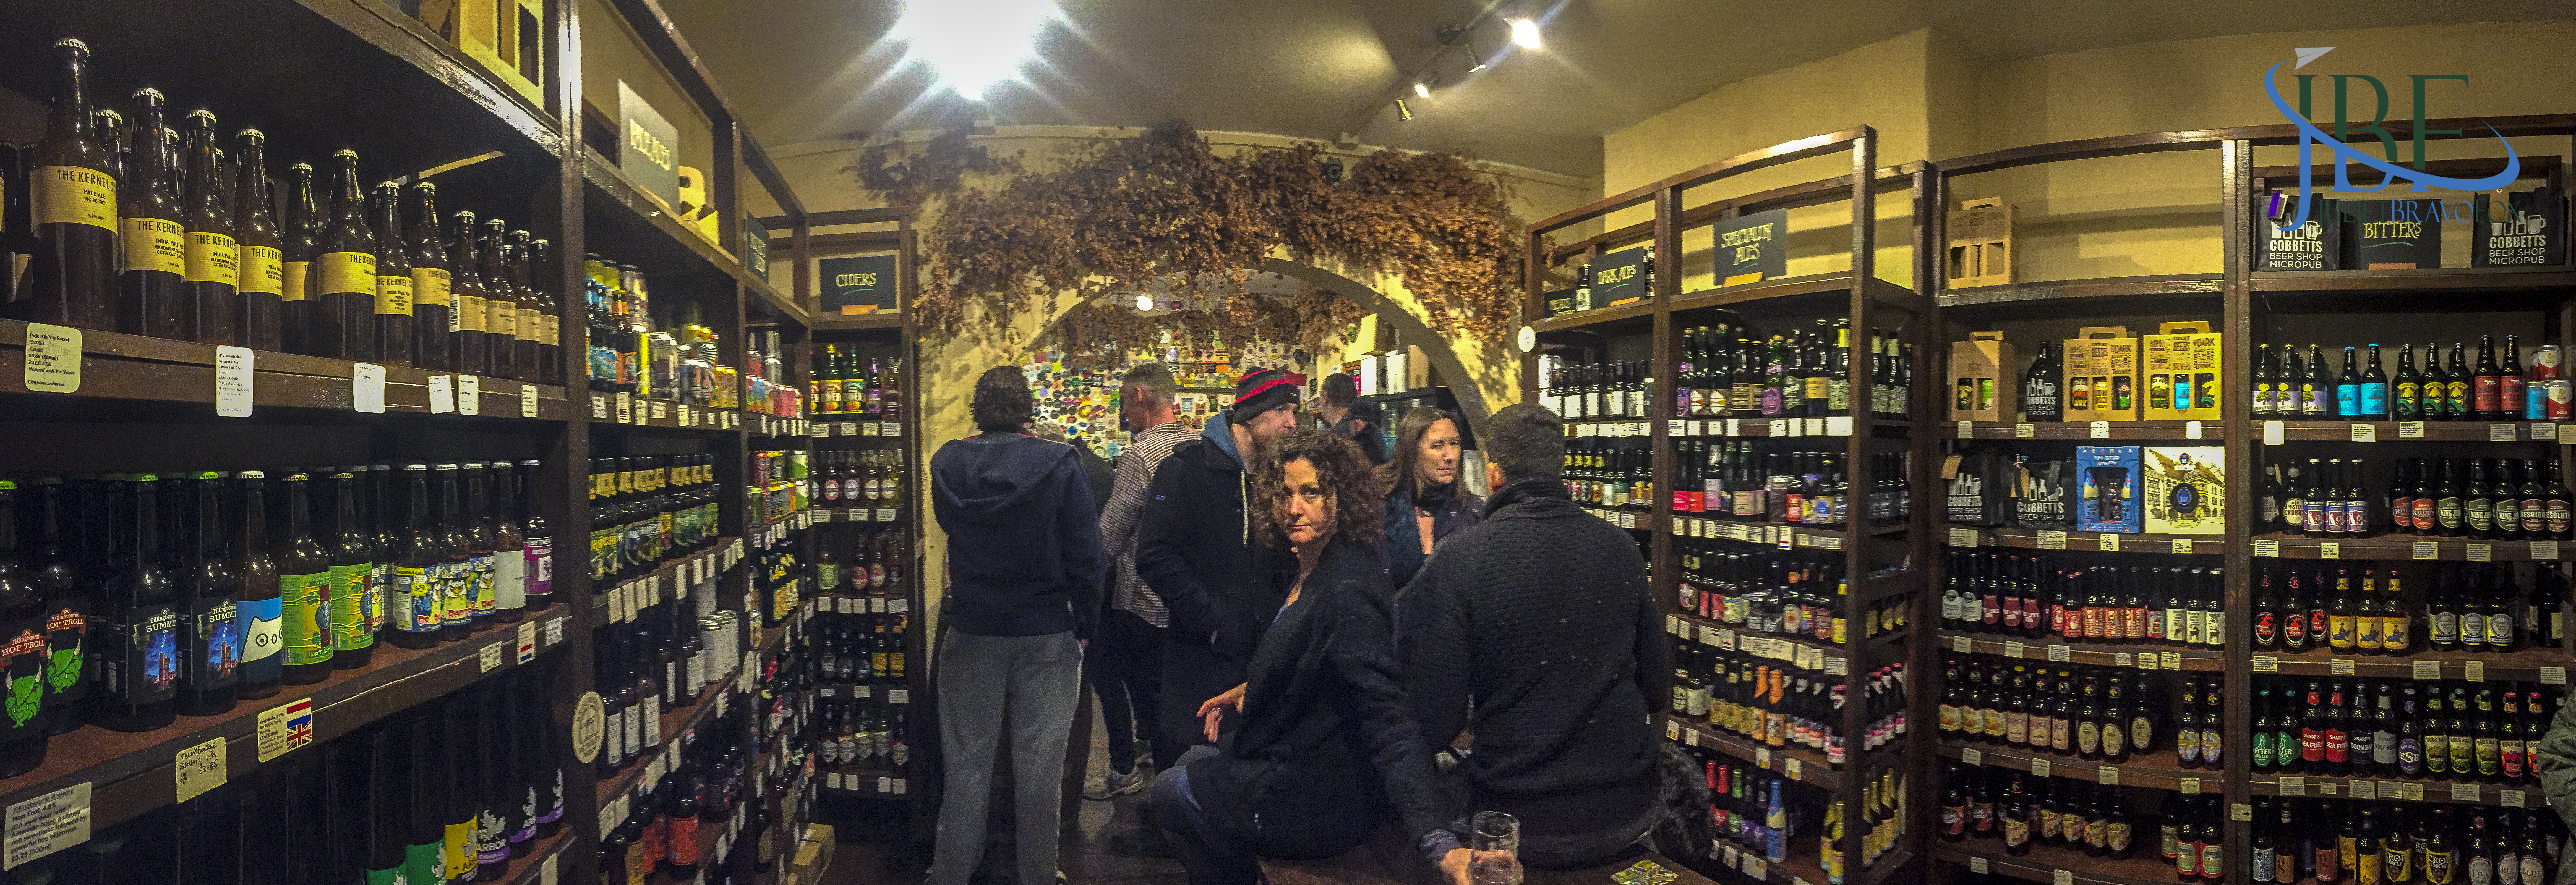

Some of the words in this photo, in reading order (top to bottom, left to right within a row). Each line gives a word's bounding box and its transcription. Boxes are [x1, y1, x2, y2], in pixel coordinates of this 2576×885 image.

[57, 170, 74, 181] THE
[79, 172, 109, 189] KERNEL
[137, 221, 153, 230] THE
[156, 221, 182, 237] KERNEL
[2363, 220, 2422, 239] BITTERS
[195, 235, 210, 244] THE
[213, 236, 234, 250] KERNEL
[2270, 240, 2322, 252] COBBETTS
[2489, 236, 2546, 249] COBBETTS
[252, 248, 265, 257] THE
[350, 255, 361, 263] THE
[1733, 243, 1760, 265] ALES
[2517, 248, 2546, 256] SHOP
[2489, 256, 2545, 265] MICROPUB
[836, 273, 877, 287] CIDERS
[1598, 268, 1617, 284] DARK
[1617, 264, 1636, 282] ALES
[213, 605, 236, 614] Tillingbourne
[150, 614, 175, 624] Tillingbourne
[12, 635, 40, 645] Tillingbourne
[1, 645, 22, 656] HOP
[24, 640, 44, 649] TROLL
[181, 742, 217, 760] TILLINGBOURNE
[2400, 751, 2419, 763] ESB
[179, 758, 202, 770] SUMMIT
[207, 751, 216, 760] IPA
[180, 772, 187, 784] 6%
[13, 797, 50, 814] Tillingbourne
[51, 789, 73, 800] Brewery
[27, 807, 41, 816] Troll
[42, 802, 57, 811] 4.8%
[11, 824, 39, 838] American
[63, 810, 81, 820] citrusy
[24, 818, 38, 826] style
[39, 813, 52, 821] beer
[24, 827, 54, 841] sweetness
[55, 818, 78, 830] followed
[11, 840, 36, 855] powerful
[50, 826, 77, 840] bitterness
[11, 851, 28, 863] £3.25
[29, 843, 52, 857] (500ml)
[2472, 870, 2490, 878] IPA
